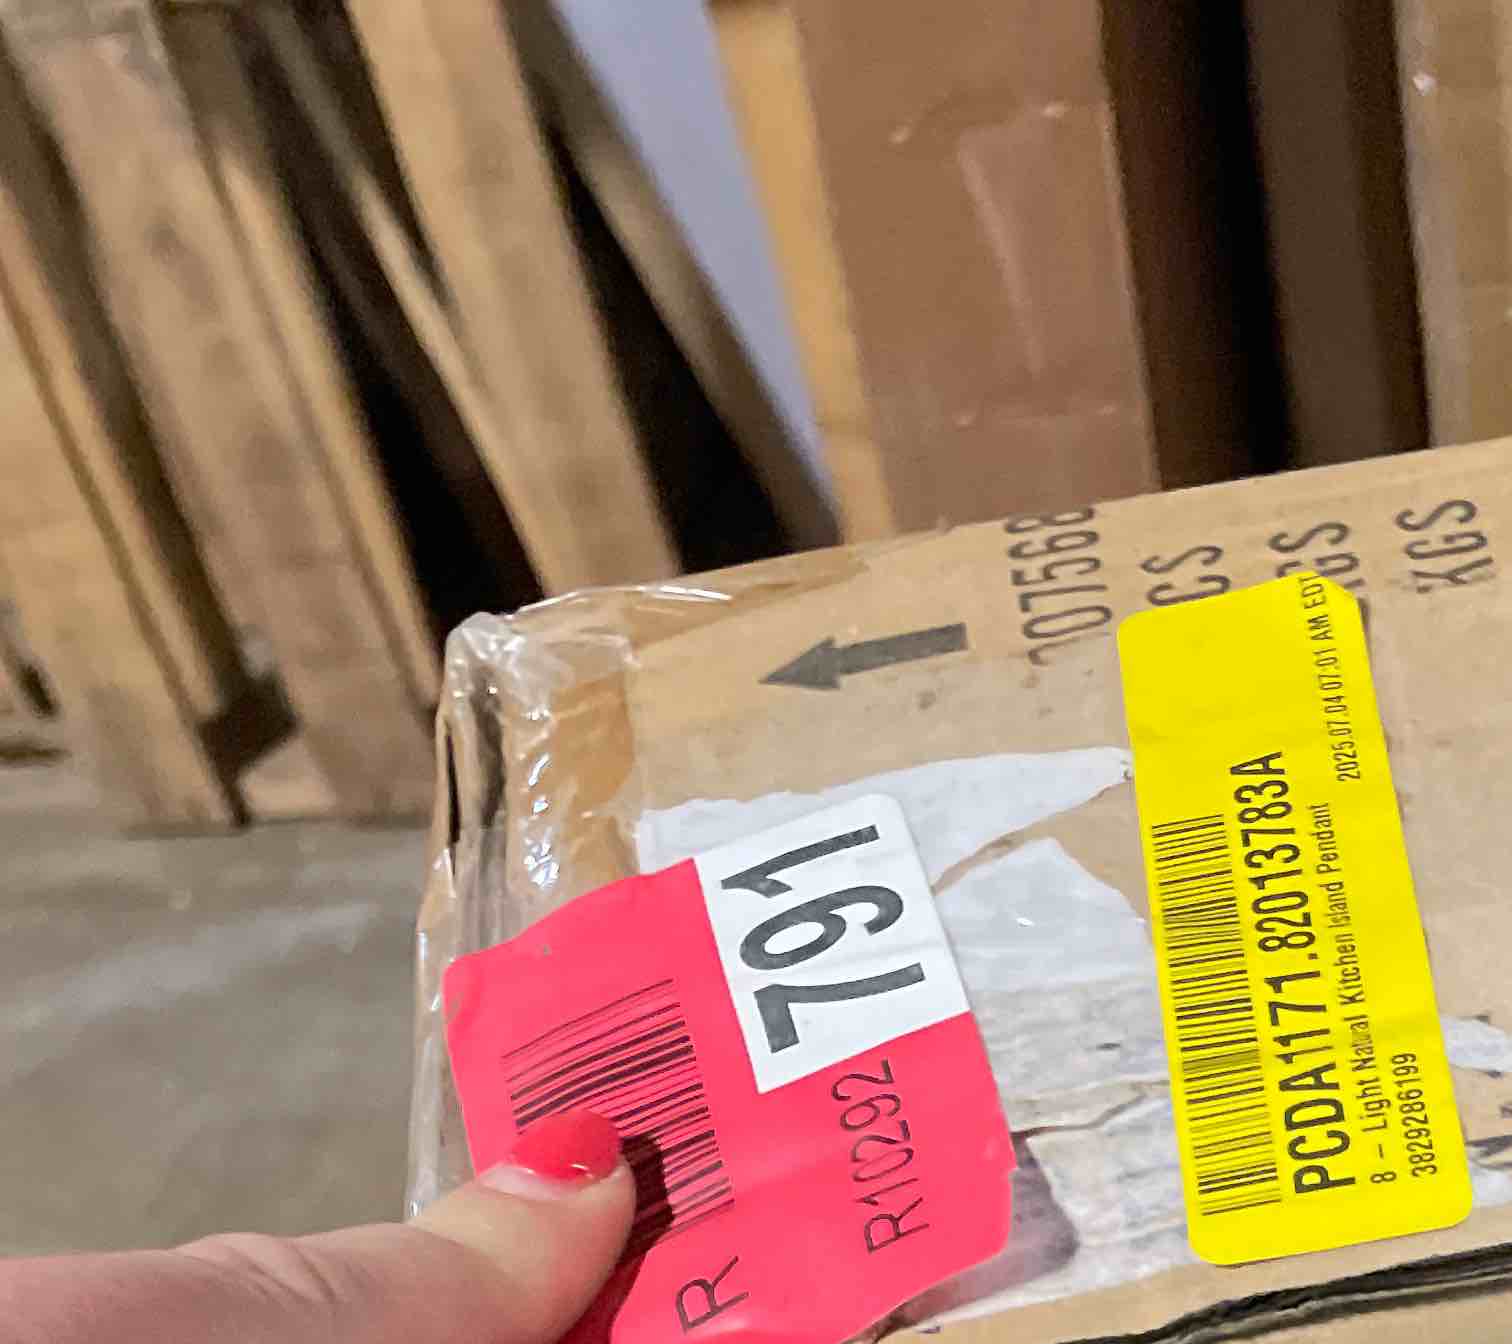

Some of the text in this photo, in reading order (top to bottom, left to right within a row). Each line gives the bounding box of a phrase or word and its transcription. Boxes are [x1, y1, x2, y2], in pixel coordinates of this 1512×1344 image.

[1306, 614, 1335, 641] AM
[1307, 802, 1342, 875] Pendant
[720, 824, 925, 1054] 791
[1319, 881, 1351, 928] Island
[1230, 752, 1356, 1194] PCDA1171.82013783A
[1332, 933, 1366, 1006] Kitchen
[1356, 1076, 1392, 1132] Light
[1391, 1053, 1437, 1178] 3829286199
[831, 1059, 930, 1253] R10292
[1370, 1170, 1397, 1184] 8
[676, 1256, 749, 1334] R
